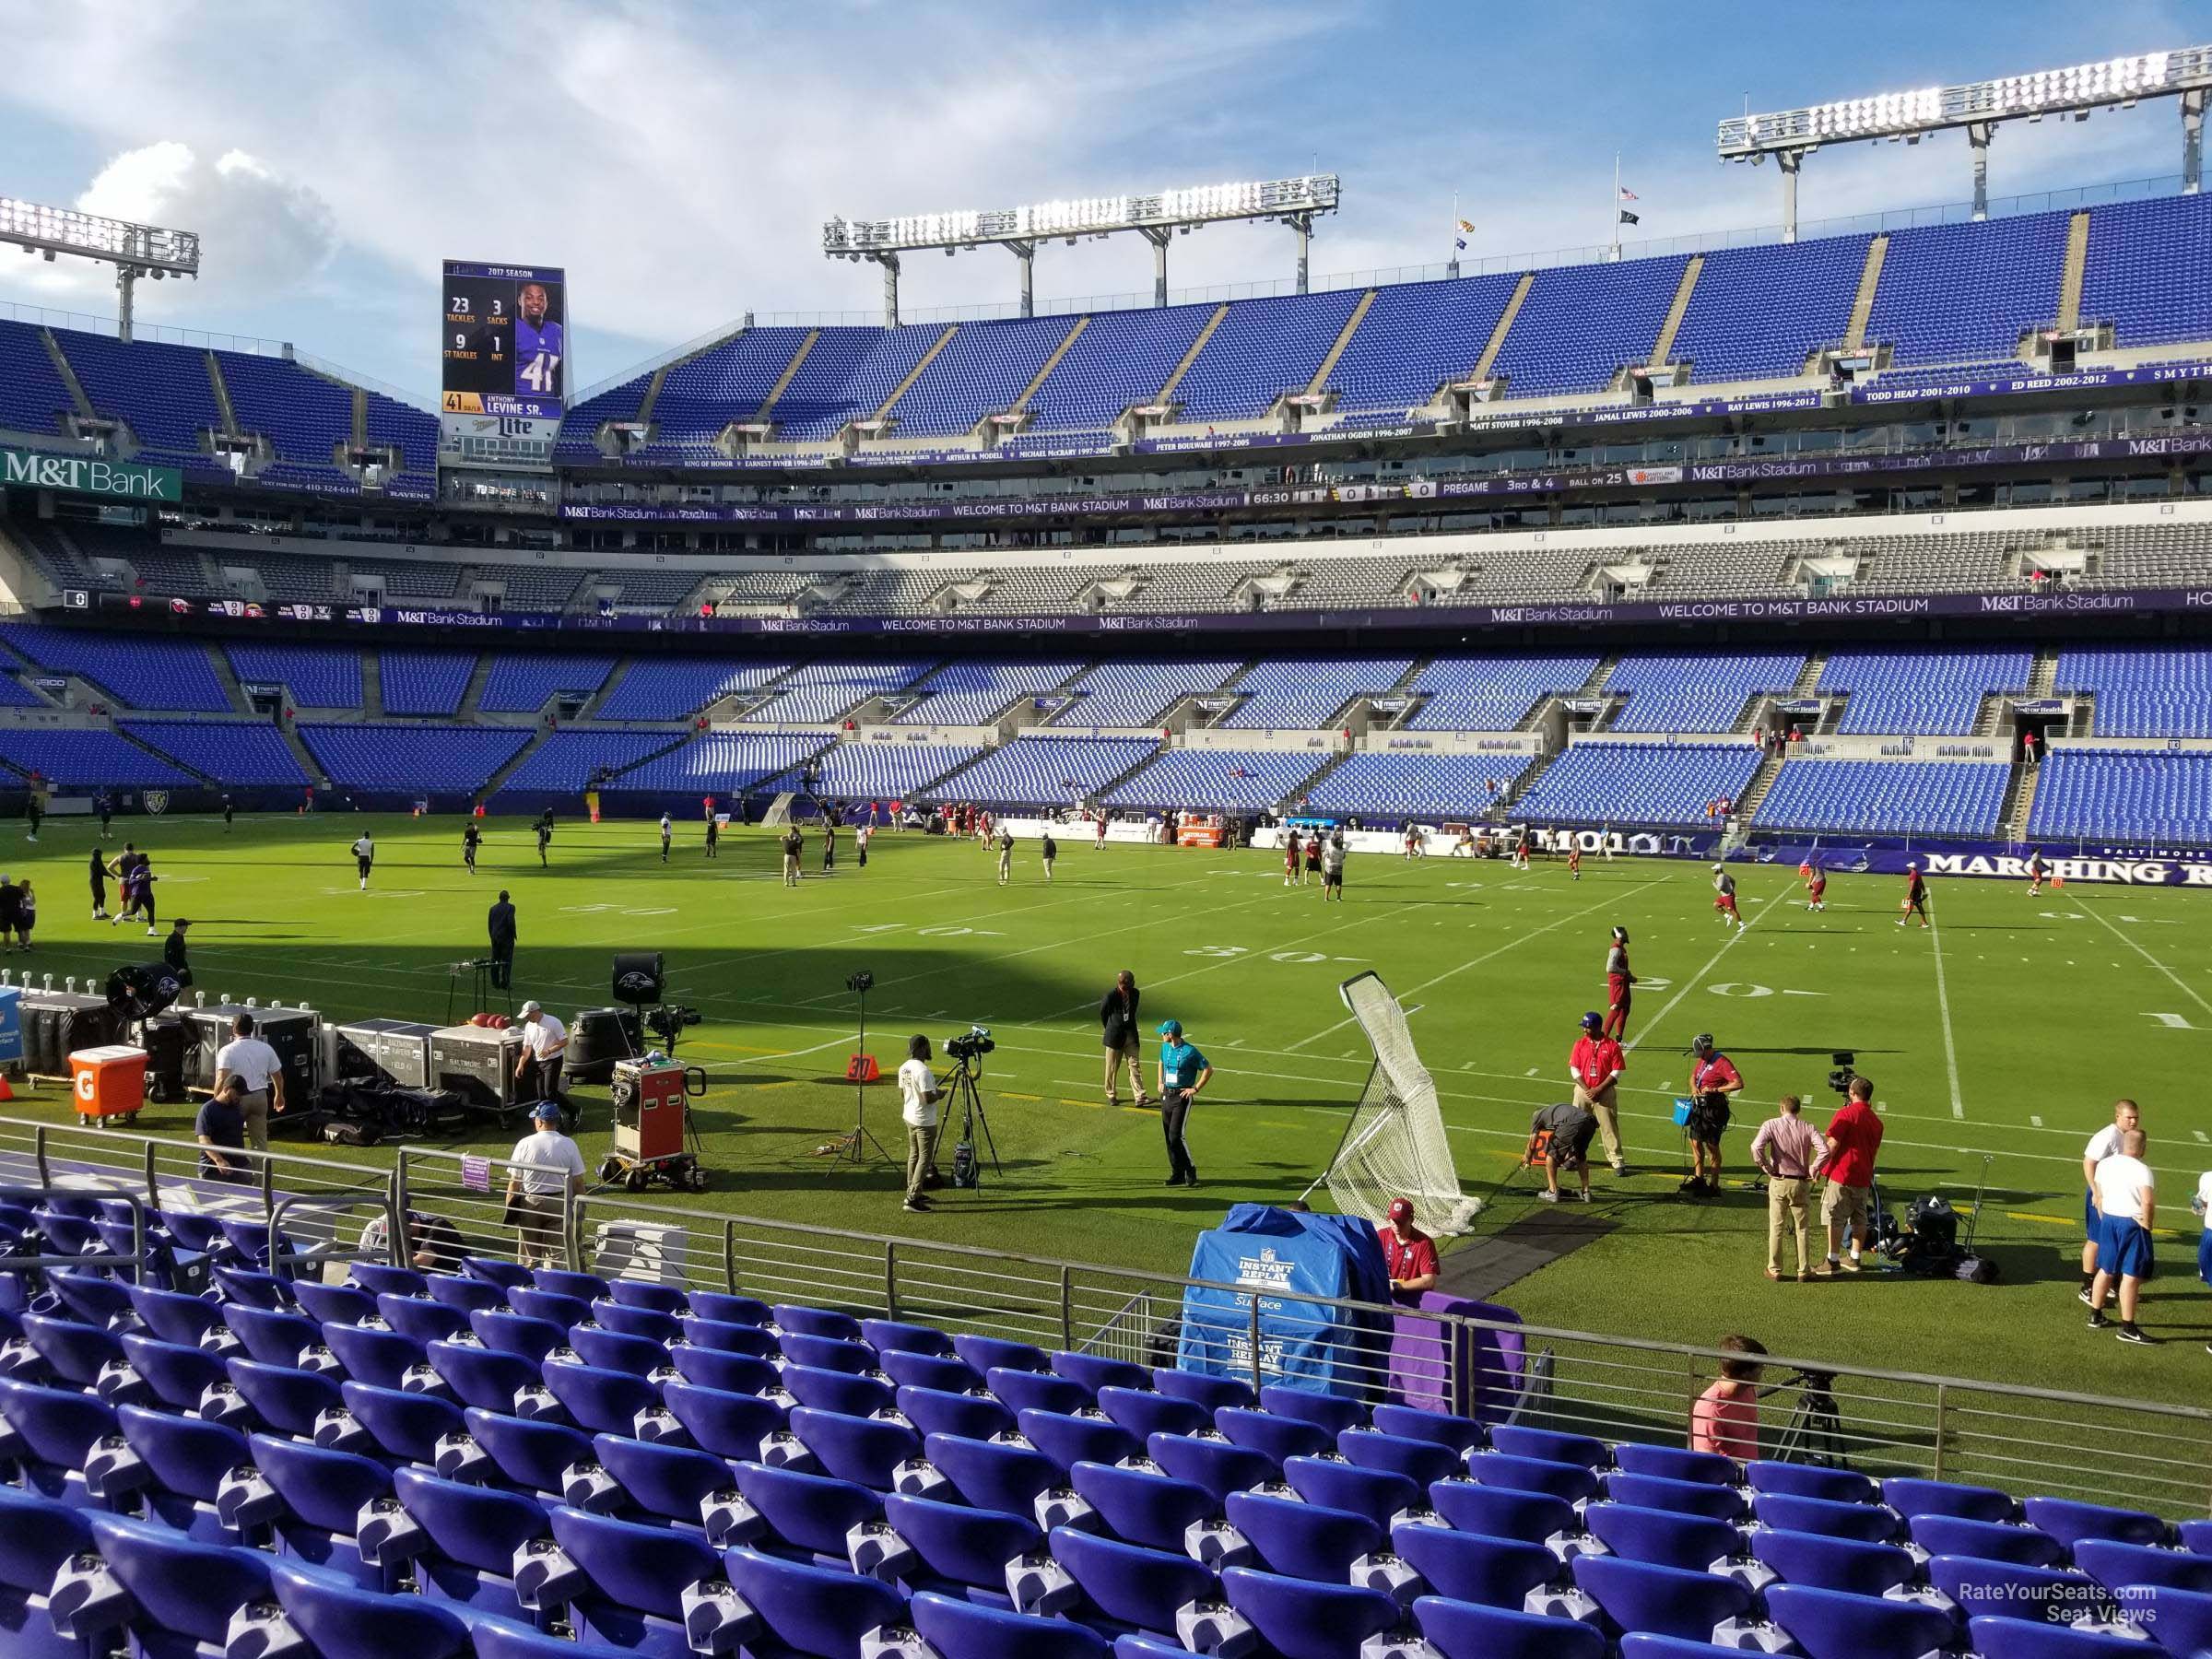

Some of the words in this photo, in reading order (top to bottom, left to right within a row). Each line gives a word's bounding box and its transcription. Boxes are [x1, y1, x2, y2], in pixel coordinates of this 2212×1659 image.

[506, 269, 533, 278] SEASON
[453, 297, 469, 312] 23
[493, 300, 501, 315] 3
[447, 314, 476, 323] TACKLES
[456, 334, 465, 349] 9
[494, 337, 499, 351] 1
[454, 351, 477, 359] TACKLES
[521, 353, 559, 391] 41
[2012, 381, 2024, 389] ED
[2027, 379, 2051, 388] REED
[2054, 375, 2107, 387] 2002-2012
[1867, 392, 1891, 401] TODD
[1894, 389, 1918, 399] HEAP
[1921, 385, 1970, 398] 2001-2010
[446, 394, 462, 410] 41
[1728, 403, 1743, 411] RAY
[1745, 401, 1770, 410] LEWIS
[1772, 398, 1815, 408] 1996-2012
[488, 404, 523, 414] LEVINE
[527, 406, 542, 415] SR.
[1594, 413, 1620, 422] JAMAL
[1623, 411, 1647, 419] LEWIS
[1649, 407, 1692, 418] 2000-2006
[498, 417, 532, 437] Lite
[1491, 420, 1520, 429] STOVER
[1522, 417, 1563, 427] 1996-2008
[1310, 432, 1346, 442] JONATHAN
[1348, 431, 1373, 439] OGDEN
[1375, 428, 1412, 438] 1996-2007
[1078, 447, 1111, 455] 1997-2002
[1178, 441, 1212, 450] BOULWARE
[1215, 439, 1249, 448] 1997-2005
[2129, 441, 2170, 454] M&T
[2171, 436, 2211, 452] Bank
[5, 452, 86, 488] M&T
[91, 462, 164, 497] Bank
[1692, 466, 1725, 480] M&T
[1727, 466, 1760, 478] Bank
[1761, 462, 1815, 476] Stadium
[1507, 480, 1527, 490] 3RD
[1532, 480, 1540, 489] &
[1545, 478, 1554, 487] 4
[1569, 478, 1588, 487] BALL
[1607, 474, 1622, 484] 25
[305, 484, 358, 494] 410-324-6141
[1444, 482, 1488, 494] PREGAME
[390, 491, 431, 499] RAVENS
[1254, 493, 1288, 504] 66:30
[954, 505, 1005, 515] WELCOME
[1009, 505, 1022, 513] TO
[1026, 503, 1048, 513] M&T
[1051, 503, 1079, 512] BANK
[1082, 500, 1128, 511] STADIUM
[1144, 498, 1170, 509] M&T
[1171, 498, 1195, 508] Bank
[1196, 496, 1237, 508] Stadium
[565, 507, 590, 517] M&T
[591, 508, 615, 517] Bank
[617, 509, 656, 519] Stadium
[856, 508, 878, 518] M&T
[880, 508, 901, 517] Bank
[902, 507, 939, 517] Stadium
[1659, 604, 1737, 618] WELCOME
[1742, 603, 1764, 616] TO
[1768, 602, 1802, 616] M&T
[1806, 600, 1851, 614] BANK
[1855, 599, 1929, 613] STADIUM
[1981, 596, 2021, 612] M&T
[2024, 595, 2063, 610] Bank
[2066, 594, 2134, 609] Stadium
[397, 611, 426, 622] M&T
[428, 612, 455, 624] Bank
[457, 613, 502, 626] Stadium
[1491, 609, 1524, 622] M&T
[1526, 608, 1558, 621] Bank
[1560, 608, 1612, 621] Stadium
[761, 621, 784, 632] M&T
[786, 621, 809, 631] Bank
[810, 621, 849, 632] Stadium
[882, 619, 937, 630] WELCOME
[940, 619, 955, 629] TO
[958, 619, 981, 629] M&T
[984, 619, 1014, 629] BANK
[1017, 619, 1065, 629] STADIUM
[1099, 618, 1126, 629] M&T
[1128, 618, 1153, 628] Bank
[1155, 617, 1198, 628] Stadium
[1577, 701, 1602, 709] merritt
[2104, 848, 2205, 858] BALTIMORE
[1924, 854, 2173, 884] MARCHING
[77, 1070, 94, 1101] G
[1239, 1261, 1294, 1273] INSTANT
[1242, 1270, 1287, 1281] REPLAY
[1232, 1350, 1278, 1364] REPAY
